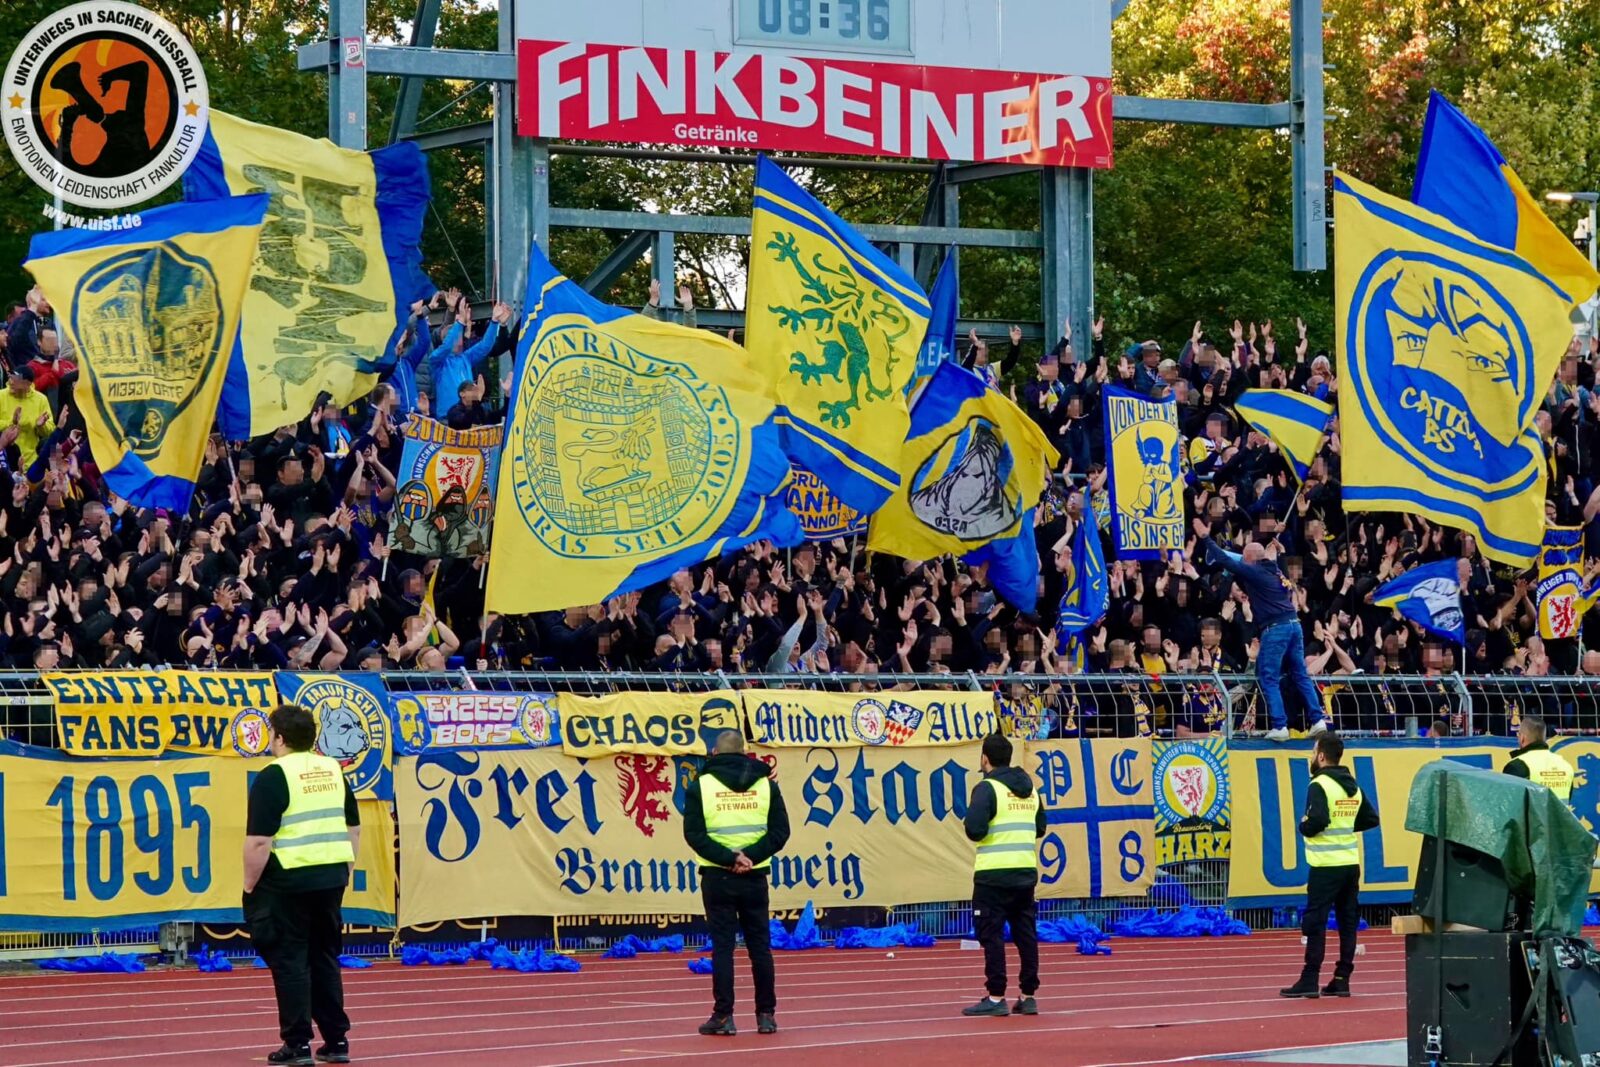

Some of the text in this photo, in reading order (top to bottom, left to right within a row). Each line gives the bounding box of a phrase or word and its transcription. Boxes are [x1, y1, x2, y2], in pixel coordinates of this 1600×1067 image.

[758, 0, 889, 40] 08:36
[538, 42, 1093, 161] FINKBEINER
[674, 122, 759, 144] Getränke
[1110, 398, 1136, 433] VON
[613, 517, 686, 555] SEIT
[1118, 513, 1142, 548] BIS
[1145, 524, 1168, 547] INS
[48, 675, 273, 707] EINTRACHT
[305, 684, 383, 749] BRAUNSCHWEIG
[426, 696, 518, 722] EXZESS
[755, 701, 849, 744] Müden
[926, 702, 997, 742] Aller
[60, 715, 161, 750] FANS
[170, 714, 229, 749] BW
[434, 723, 513, 744] BOYS
[565, 713, 697, 748] CHAOS
[303, 783, 338, 794] SECURITY
[415, 746, 970, 862] Frei Staa
[716, 802, 759, 811] STEWARD
[46, 771, 212, 900] 1895
[1155, 831, 1231, 866] HARZ
[1119, 830, 1146, 882] 8
